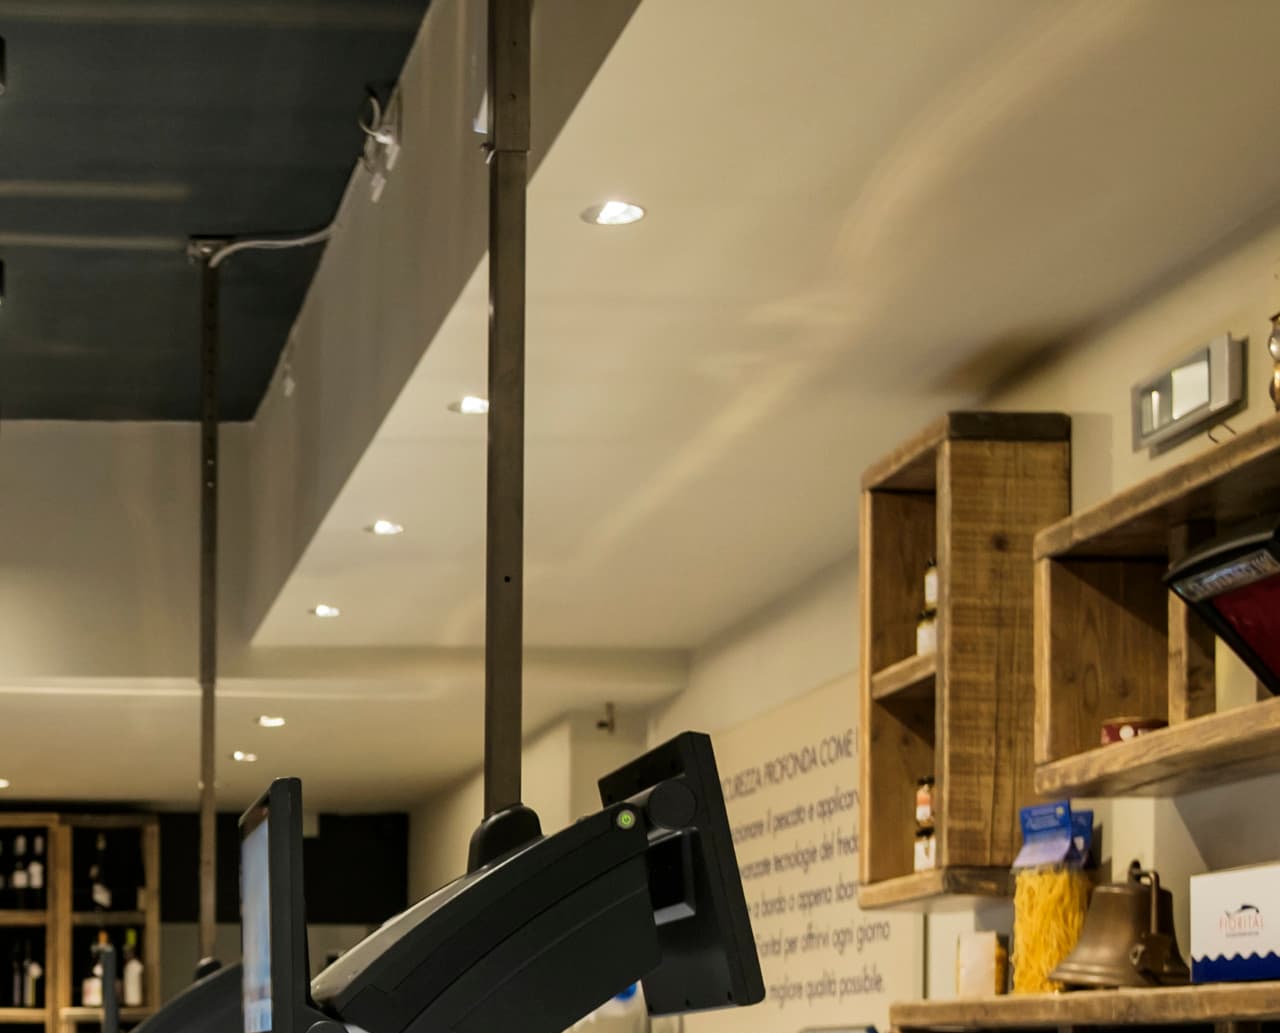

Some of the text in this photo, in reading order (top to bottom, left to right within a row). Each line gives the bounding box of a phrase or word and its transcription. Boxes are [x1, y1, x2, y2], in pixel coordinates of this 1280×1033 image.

[722, 767, 762, 801] CUREZZA
[820, 728, 853, 768] COME
[816, 784, 858, 823] applicar
[773, 838, 817, 874] tecnologie
[820, 831, 833, 861] del
[798, 887, 832, 915] appena
[785, 936, 798, 961] per
[832, 920, 853, 956] ogni
[857, 918, 890, 952] giorno
[770, 973, 803, 1009] migliore
